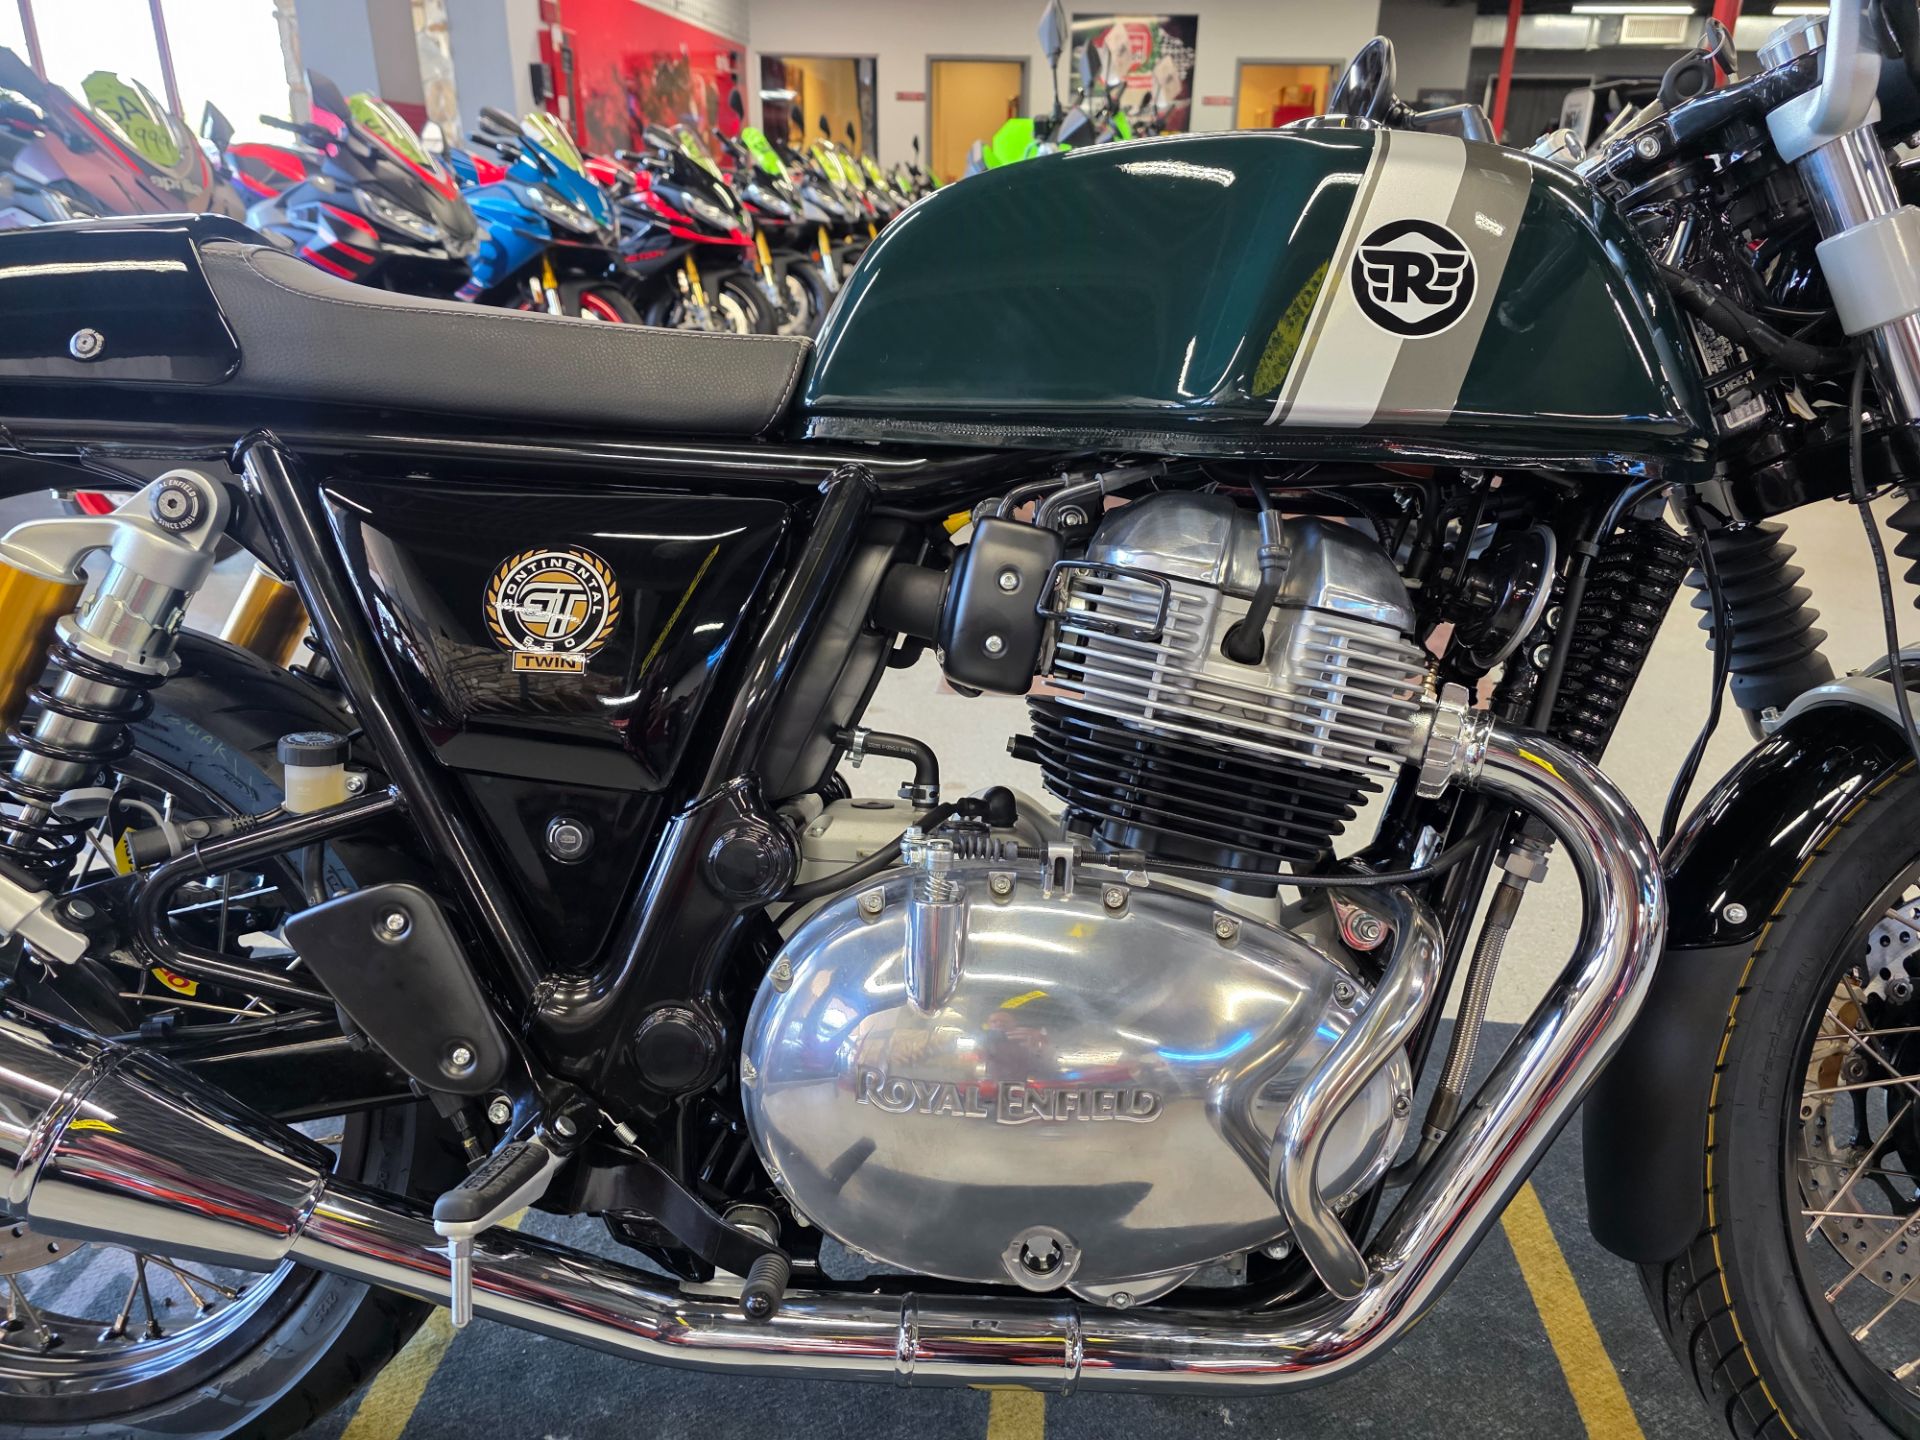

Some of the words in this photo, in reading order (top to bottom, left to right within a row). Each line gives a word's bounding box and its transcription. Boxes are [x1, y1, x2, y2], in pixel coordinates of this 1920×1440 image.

[169, 480, 196, 497] ENFIELD
[158, 518, 179, 529] SINCE
[499, 558, 603, 615] CONTINENTAL
[521, 655, 577, 669] TWIN
[856, 1065, 988, 1118] ROYAL
[996, 1081, 1165, 1125] ENFIELD
